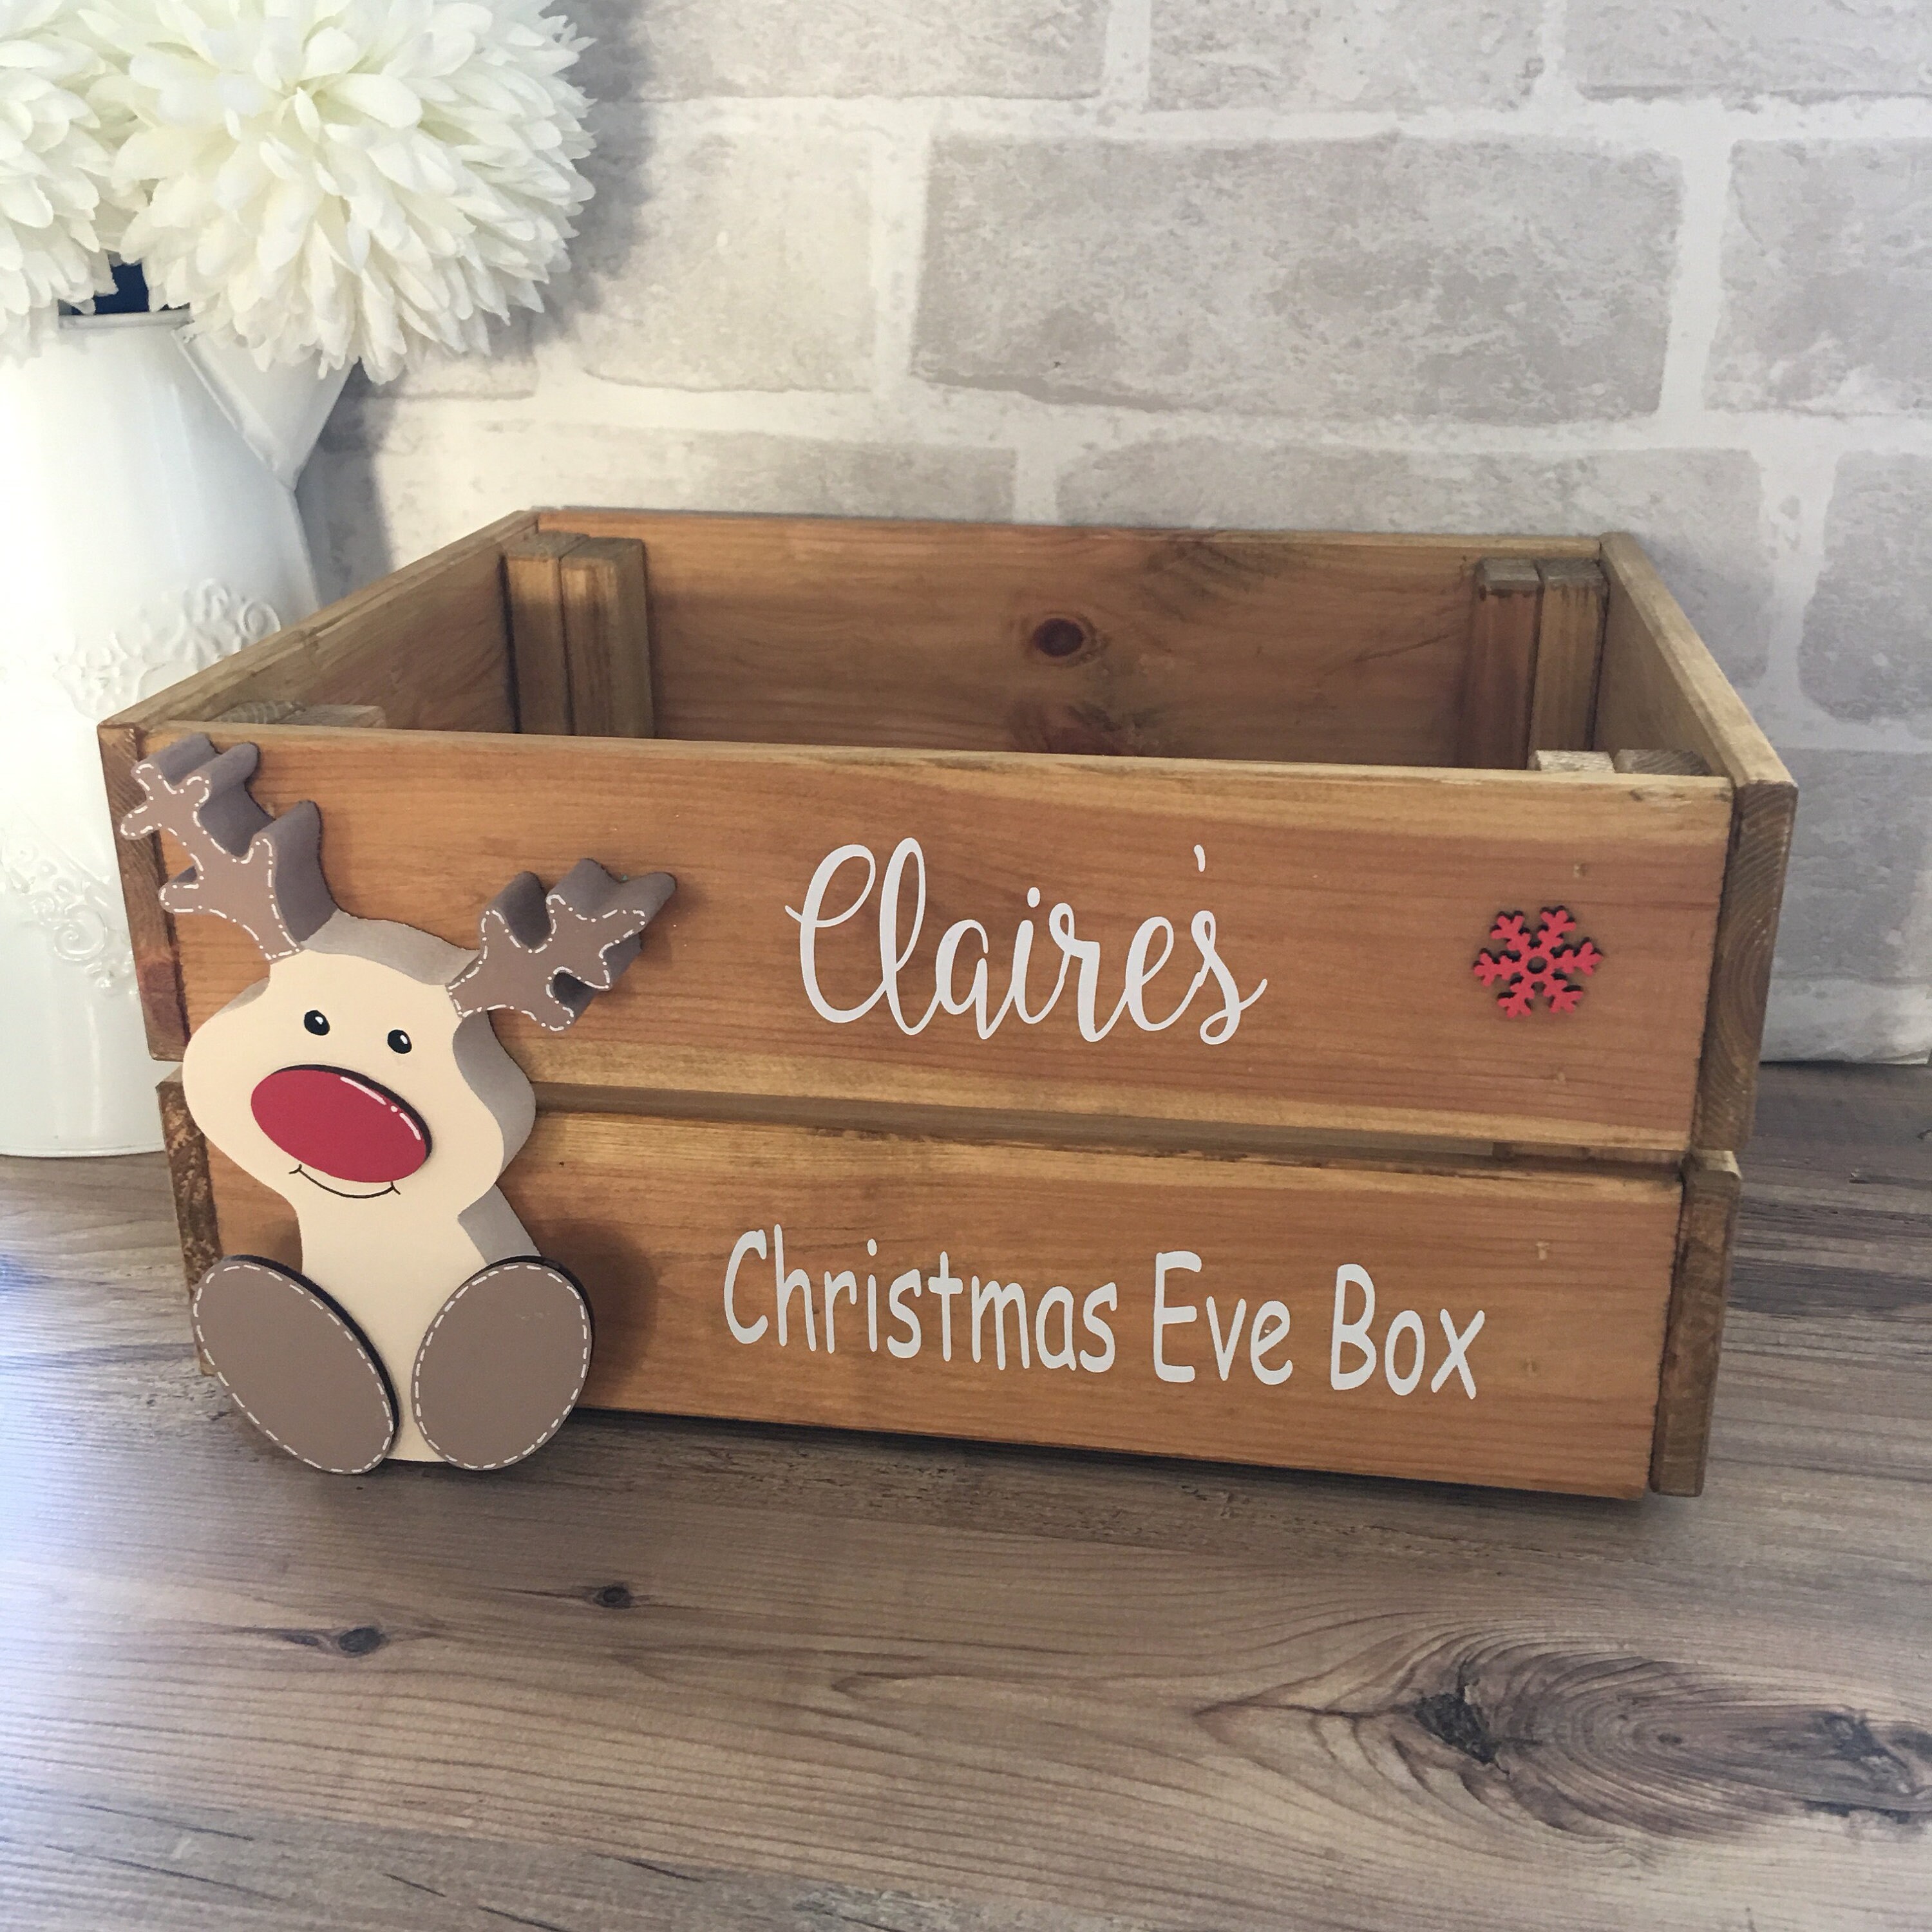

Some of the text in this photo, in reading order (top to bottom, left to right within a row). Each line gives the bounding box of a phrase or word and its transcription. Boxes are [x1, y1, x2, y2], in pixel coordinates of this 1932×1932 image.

[784, 837, 1269, 1046] Claire's
[723, 1223, 1486, 1400] Christmas Eve Box
